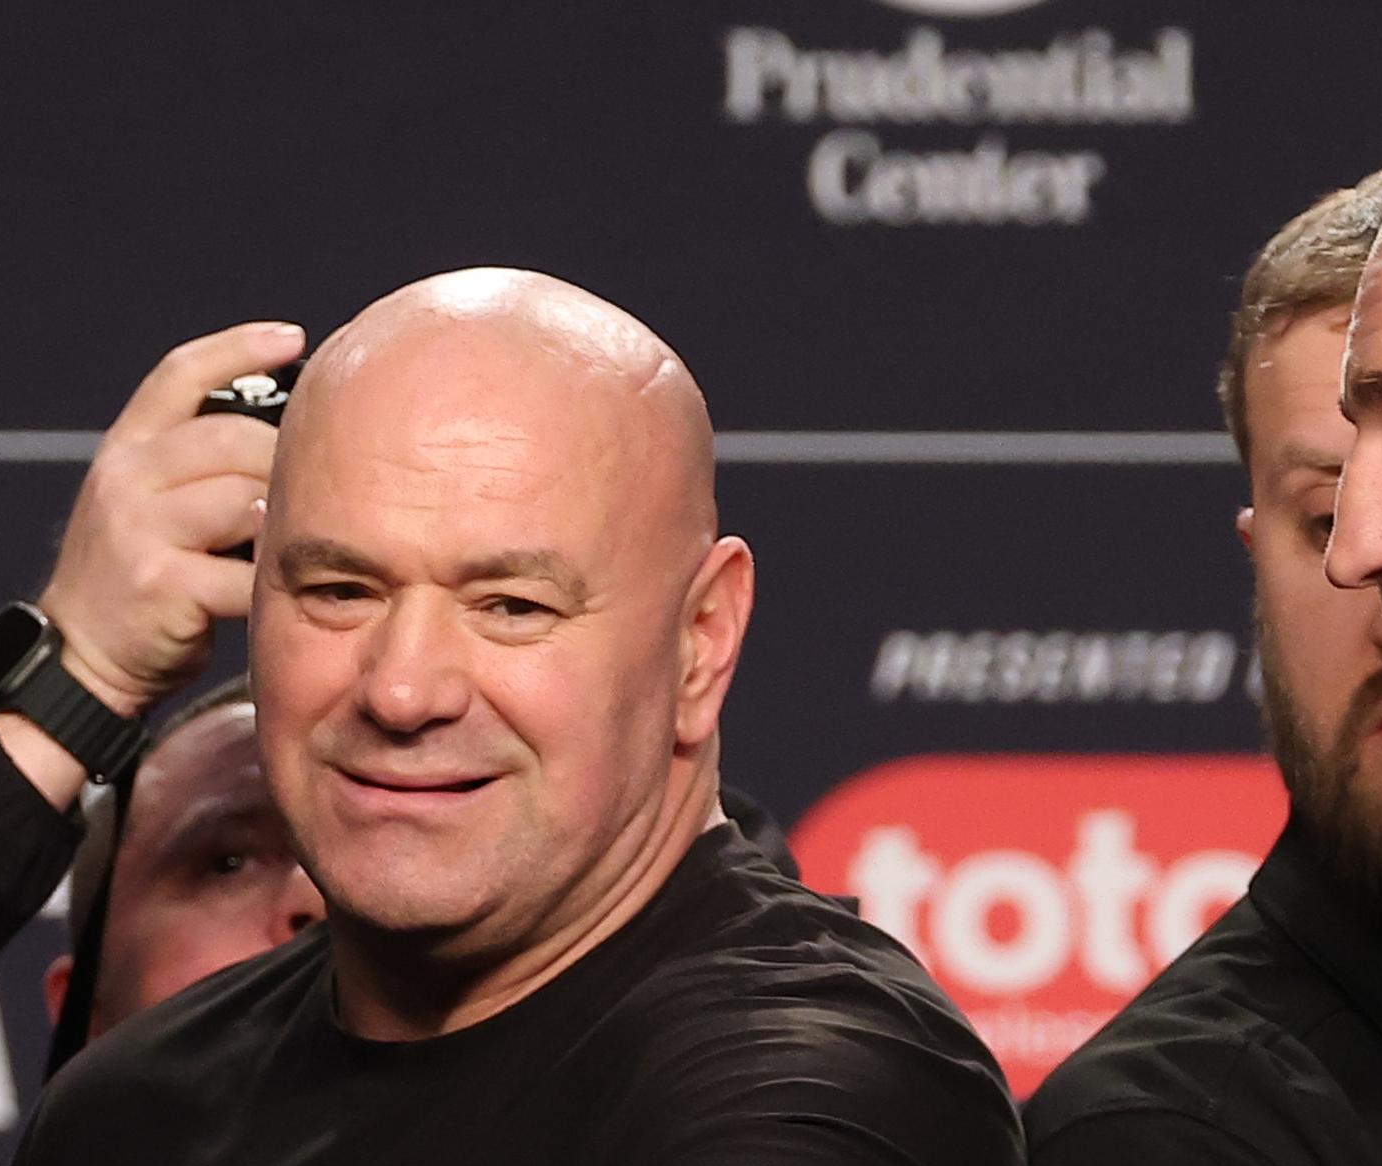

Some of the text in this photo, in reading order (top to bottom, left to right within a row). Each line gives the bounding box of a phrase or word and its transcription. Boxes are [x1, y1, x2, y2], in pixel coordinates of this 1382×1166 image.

[725, 24, 1194, 122] Prudential
[807, 128, 1106, 225] Center
[870, 630, 1237, 700] PRESENTED
